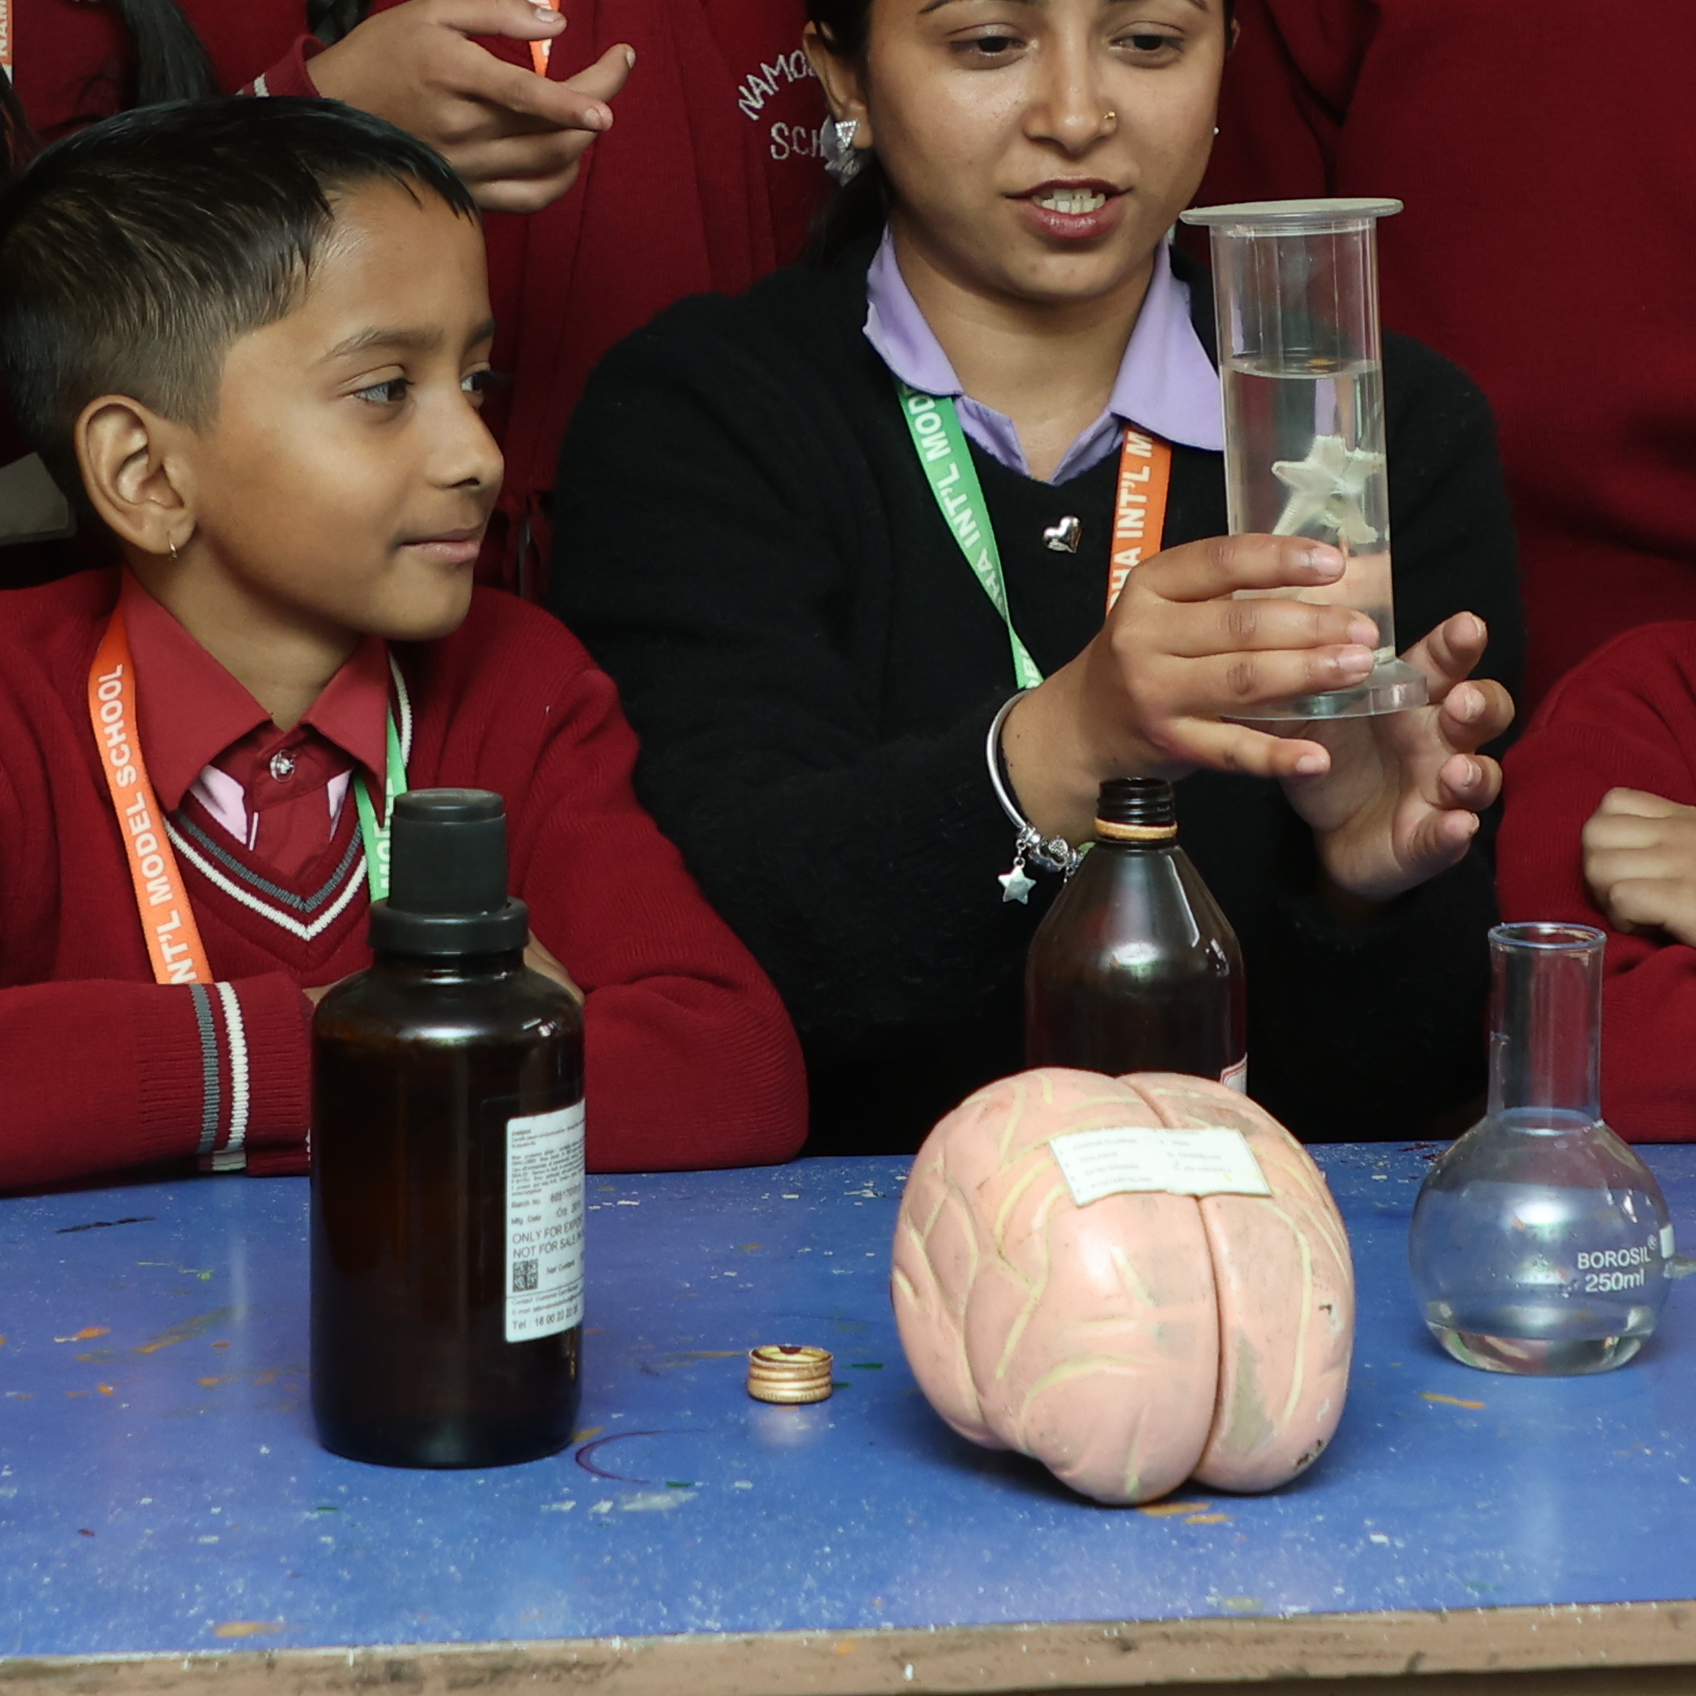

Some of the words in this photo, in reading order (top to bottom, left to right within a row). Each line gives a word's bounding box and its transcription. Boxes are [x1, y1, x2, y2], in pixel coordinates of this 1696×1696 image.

[738, 49, 818, 122] NAMO
[770, 121, 826, 160] SCH
[907, 392, 953, 463] MOD
[935, 462, 983, 549] INT'L
[1116, 465, 1152, 539] INT'L
[97, 662, 138, 788] SCHOOL
[124, 791, 176, 906] MODEL
[156, 909, 198, 985] NT'L
[512, 1230, 543, 1245] ONLY
[544, 1223, 563, 1239] FOR
[512, 1245, 538, 1260] NOT
[539, 1239, 559, 1257] FOR
[1576, 1247, 1652, 1271] BOROSIL
[1584, 1268, 1646, 1294] 250ml
